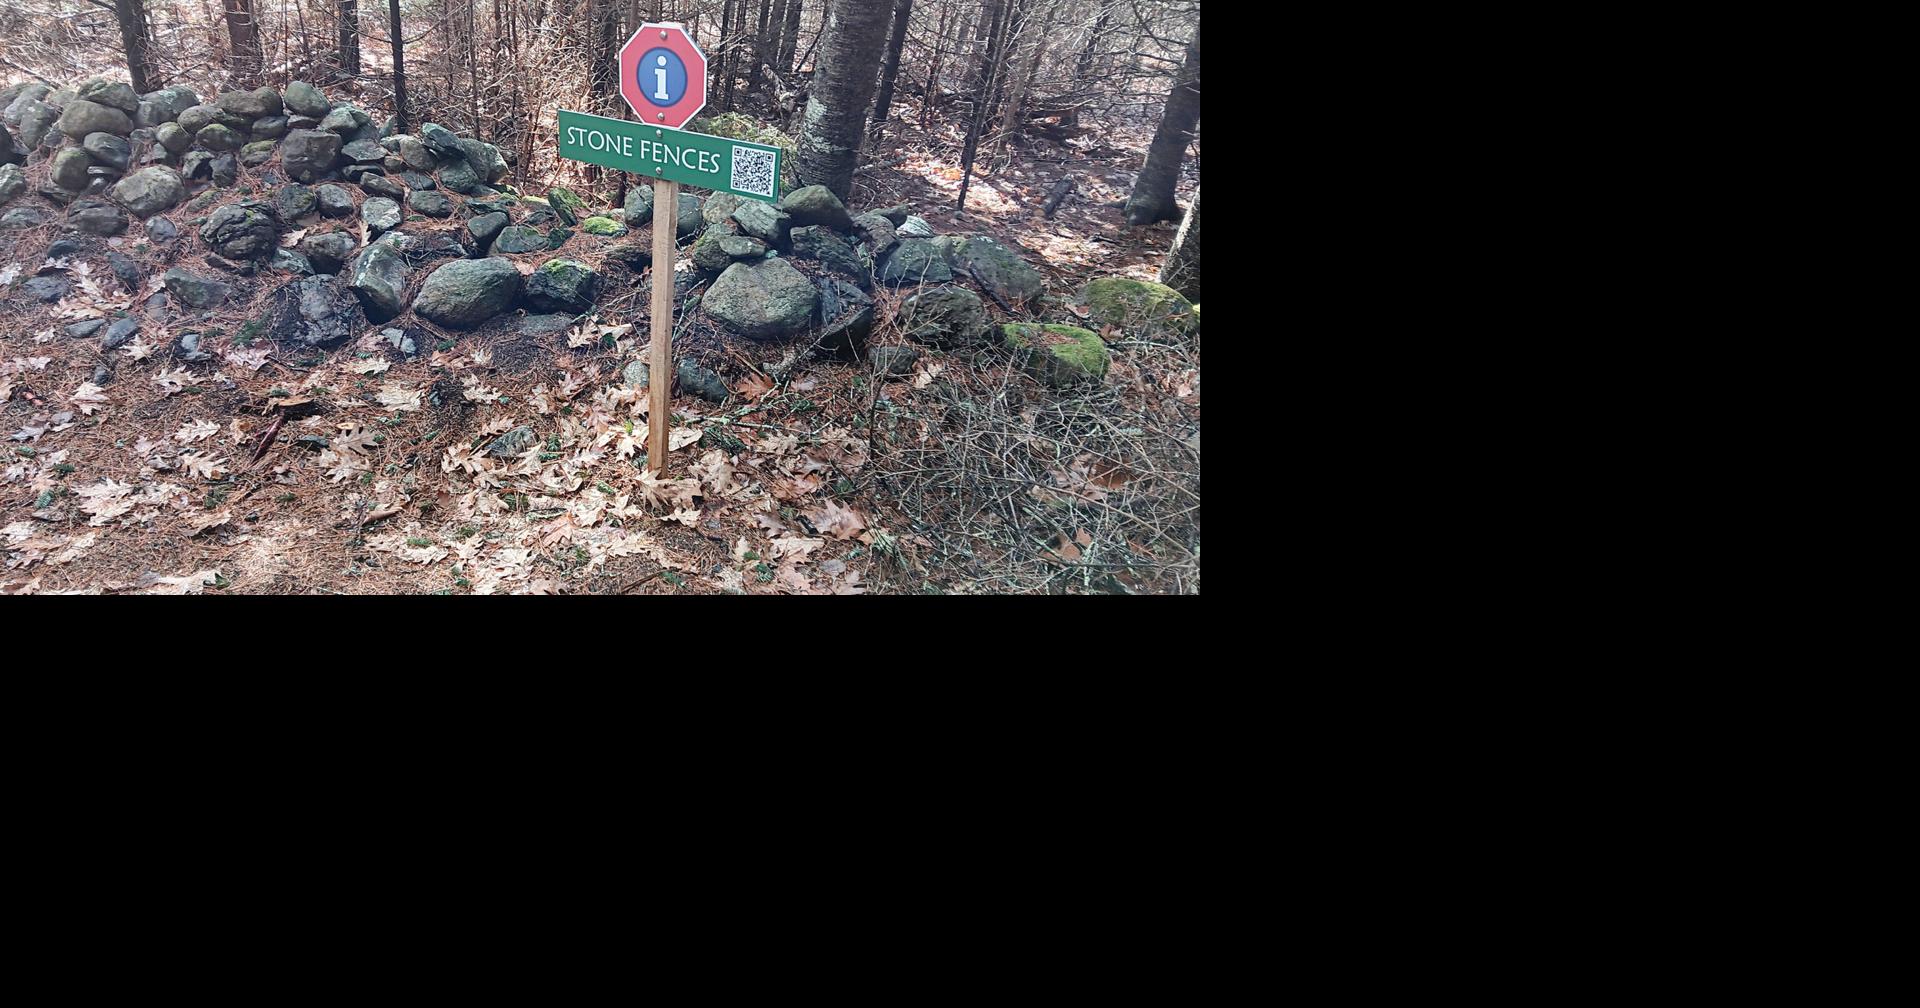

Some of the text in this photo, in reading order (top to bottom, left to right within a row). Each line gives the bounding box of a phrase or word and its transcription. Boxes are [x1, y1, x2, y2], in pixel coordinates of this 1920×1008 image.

[654, 55, 669, 100] i
[567, 126, 721, 174] STONE FENCES
